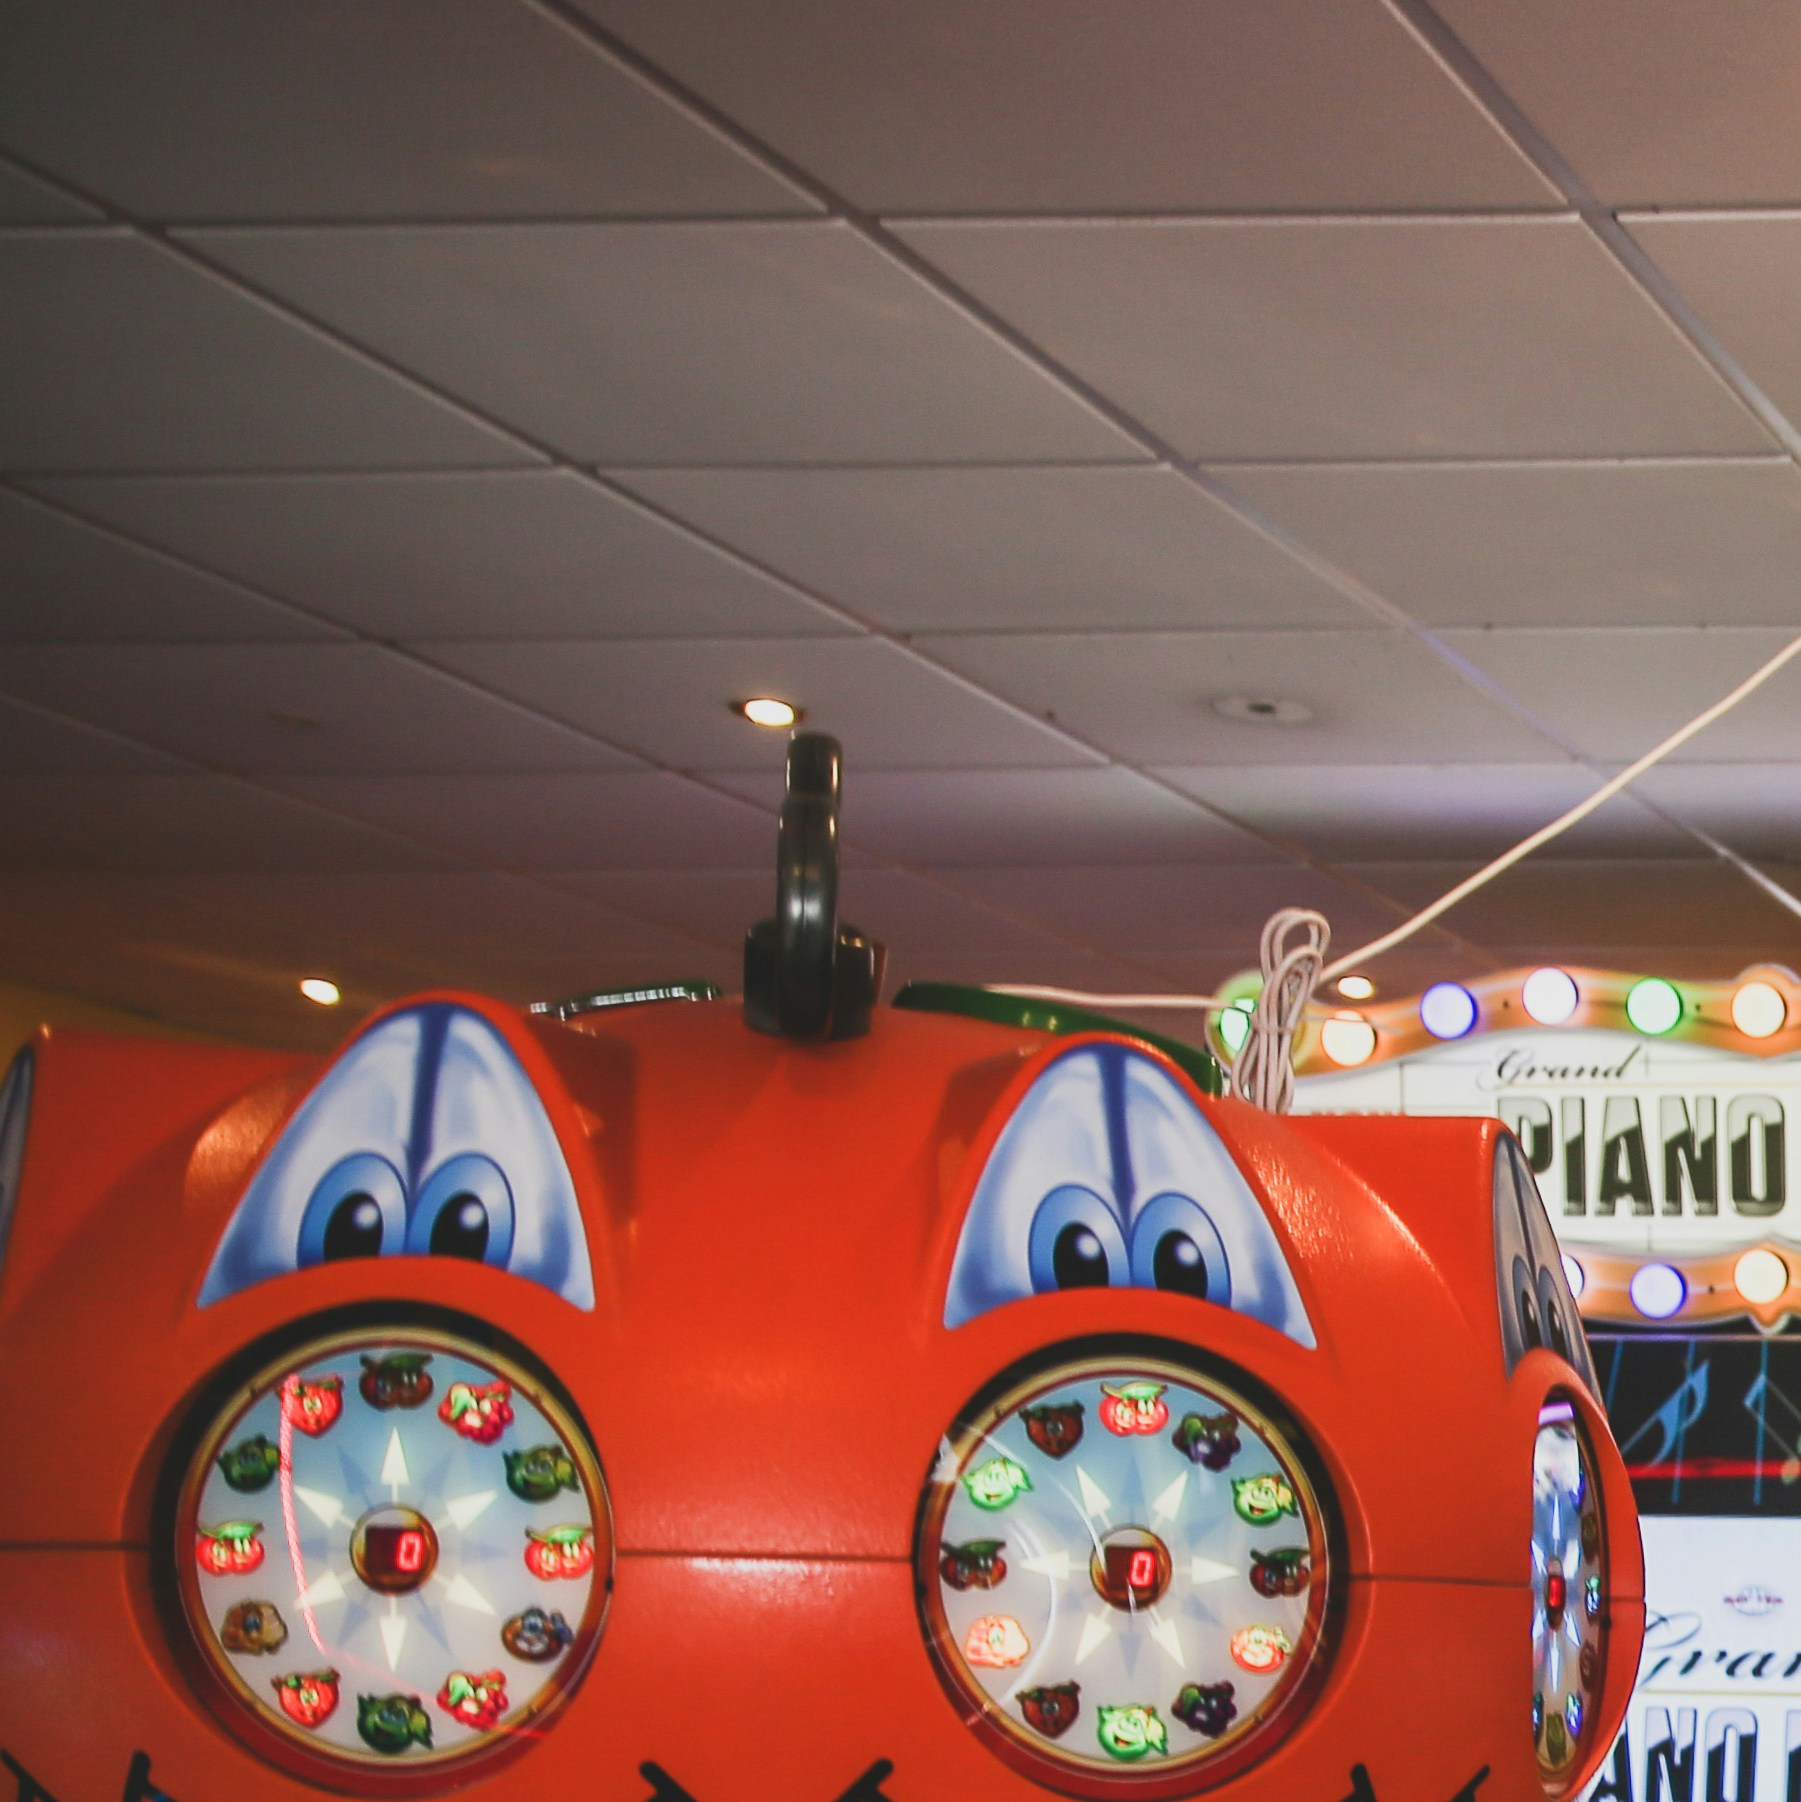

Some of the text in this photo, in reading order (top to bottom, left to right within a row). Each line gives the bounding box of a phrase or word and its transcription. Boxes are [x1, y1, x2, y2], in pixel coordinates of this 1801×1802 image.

[1478, 1046, 1642, 1091] Grand
[1495, 1094, 1786, 1218] PIANO
[396, 1531, 423, 1572] 0
[1130, 1550, 1155, 1587] 0
